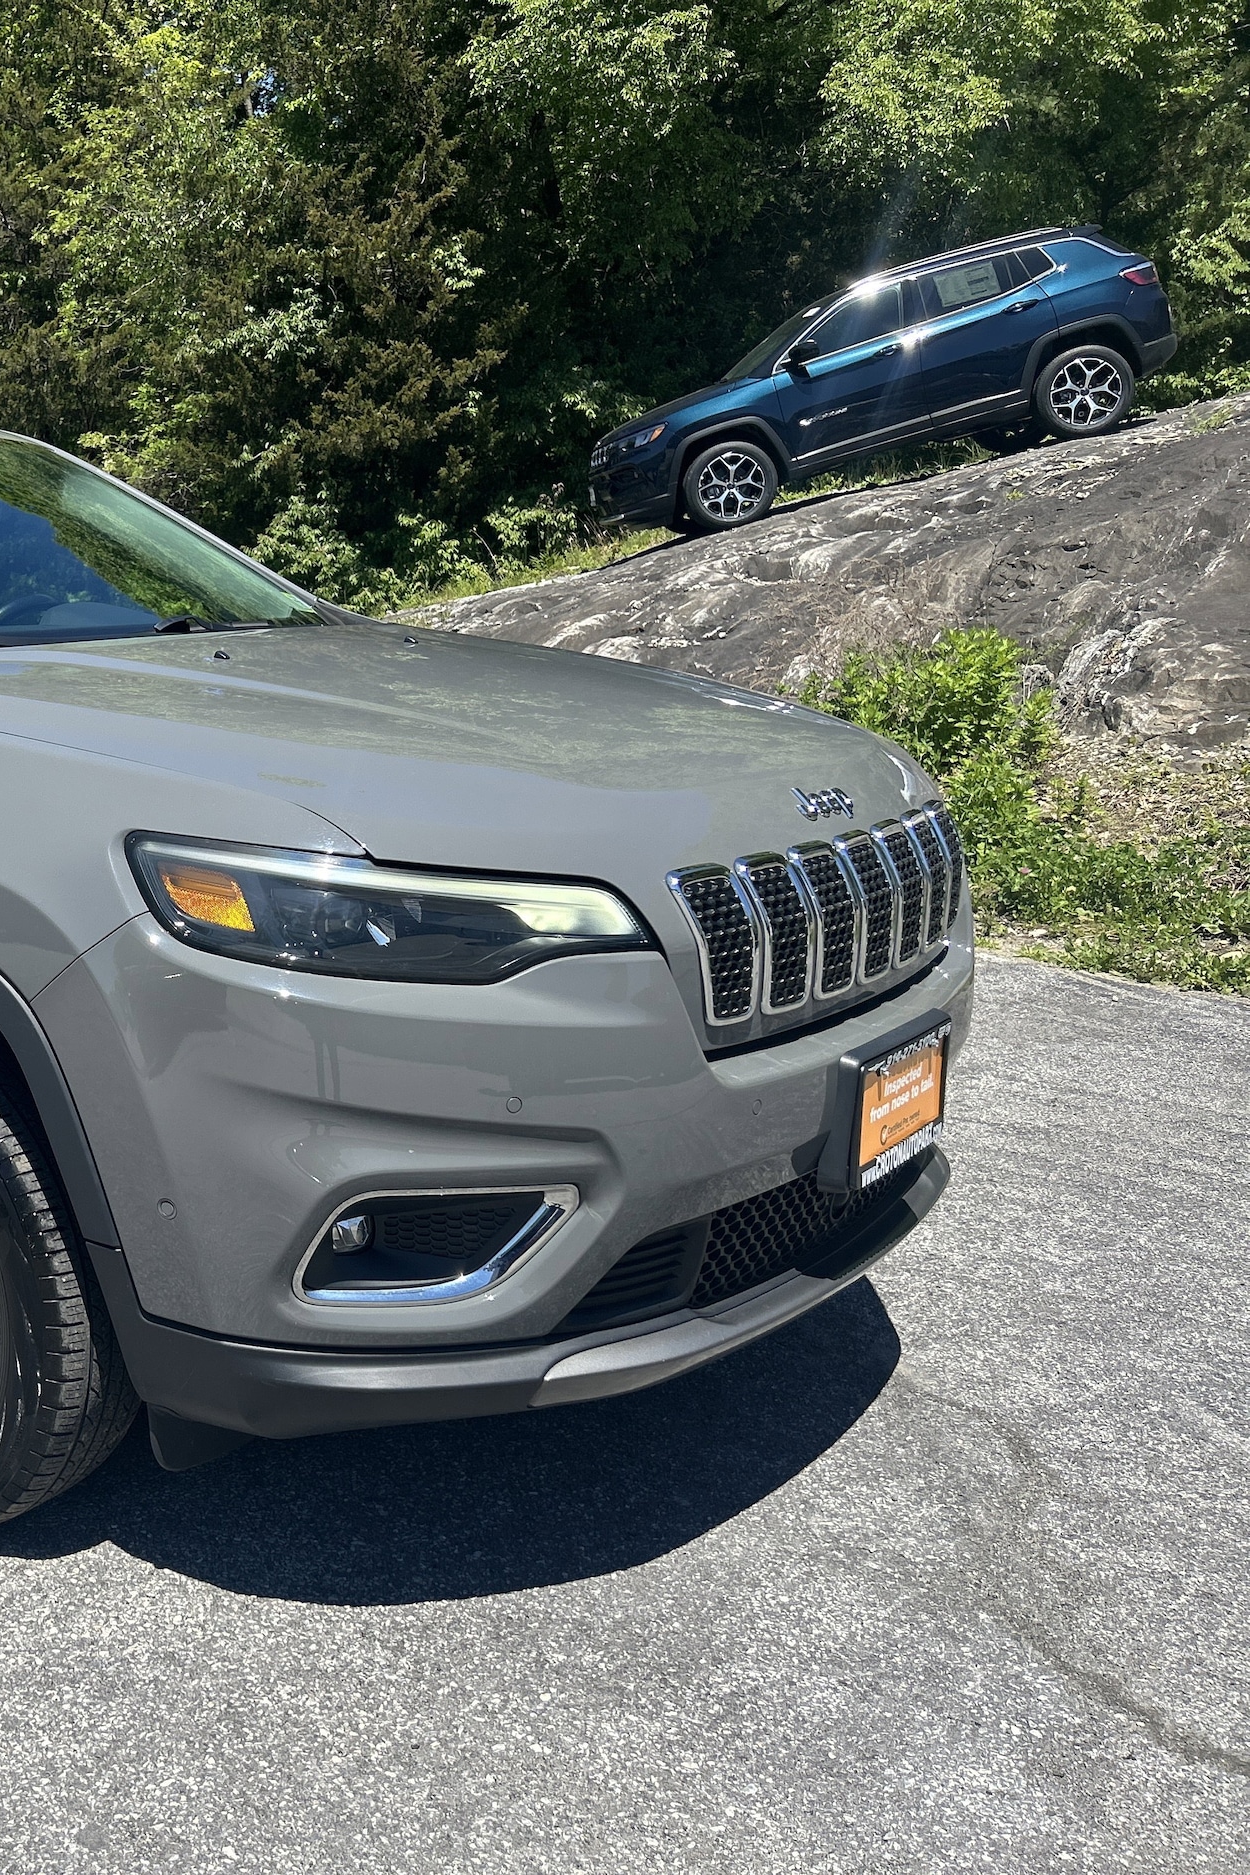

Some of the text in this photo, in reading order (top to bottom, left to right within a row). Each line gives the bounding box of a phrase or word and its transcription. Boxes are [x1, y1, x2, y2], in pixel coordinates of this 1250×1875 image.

[791, 787, 854, 821] Jeep
[883, 1062, 923, 1097] Inspected
[869, 1102, 890, 1123] from
[891, 1091, 911, 1111] nose
[911, 1084, 920, 1099] to
